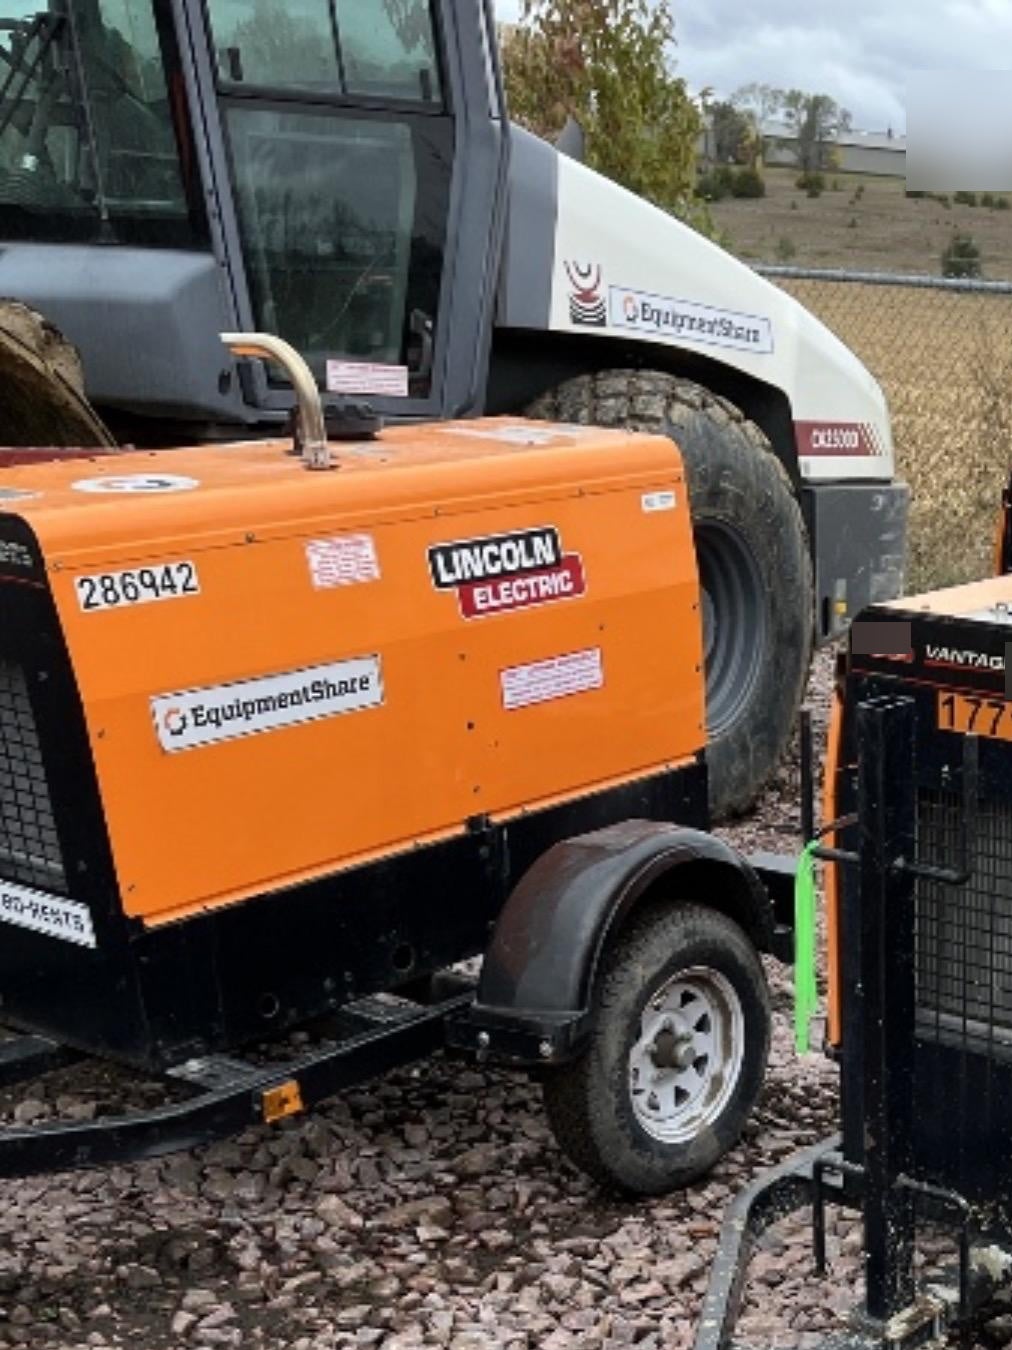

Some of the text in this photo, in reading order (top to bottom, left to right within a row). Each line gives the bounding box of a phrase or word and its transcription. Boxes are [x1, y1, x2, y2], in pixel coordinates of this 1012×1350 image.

[641, 302, 760, 343] EquipmentShare
[434, 535, 557, 583] LINCOLN
[78, 563, 197, 610] 286942
[473, 573, 575, 611] ELECTRIC
[925, 643, 1005, 670] VANTAG
[190, 673, 371, 731] EquipmentShare
